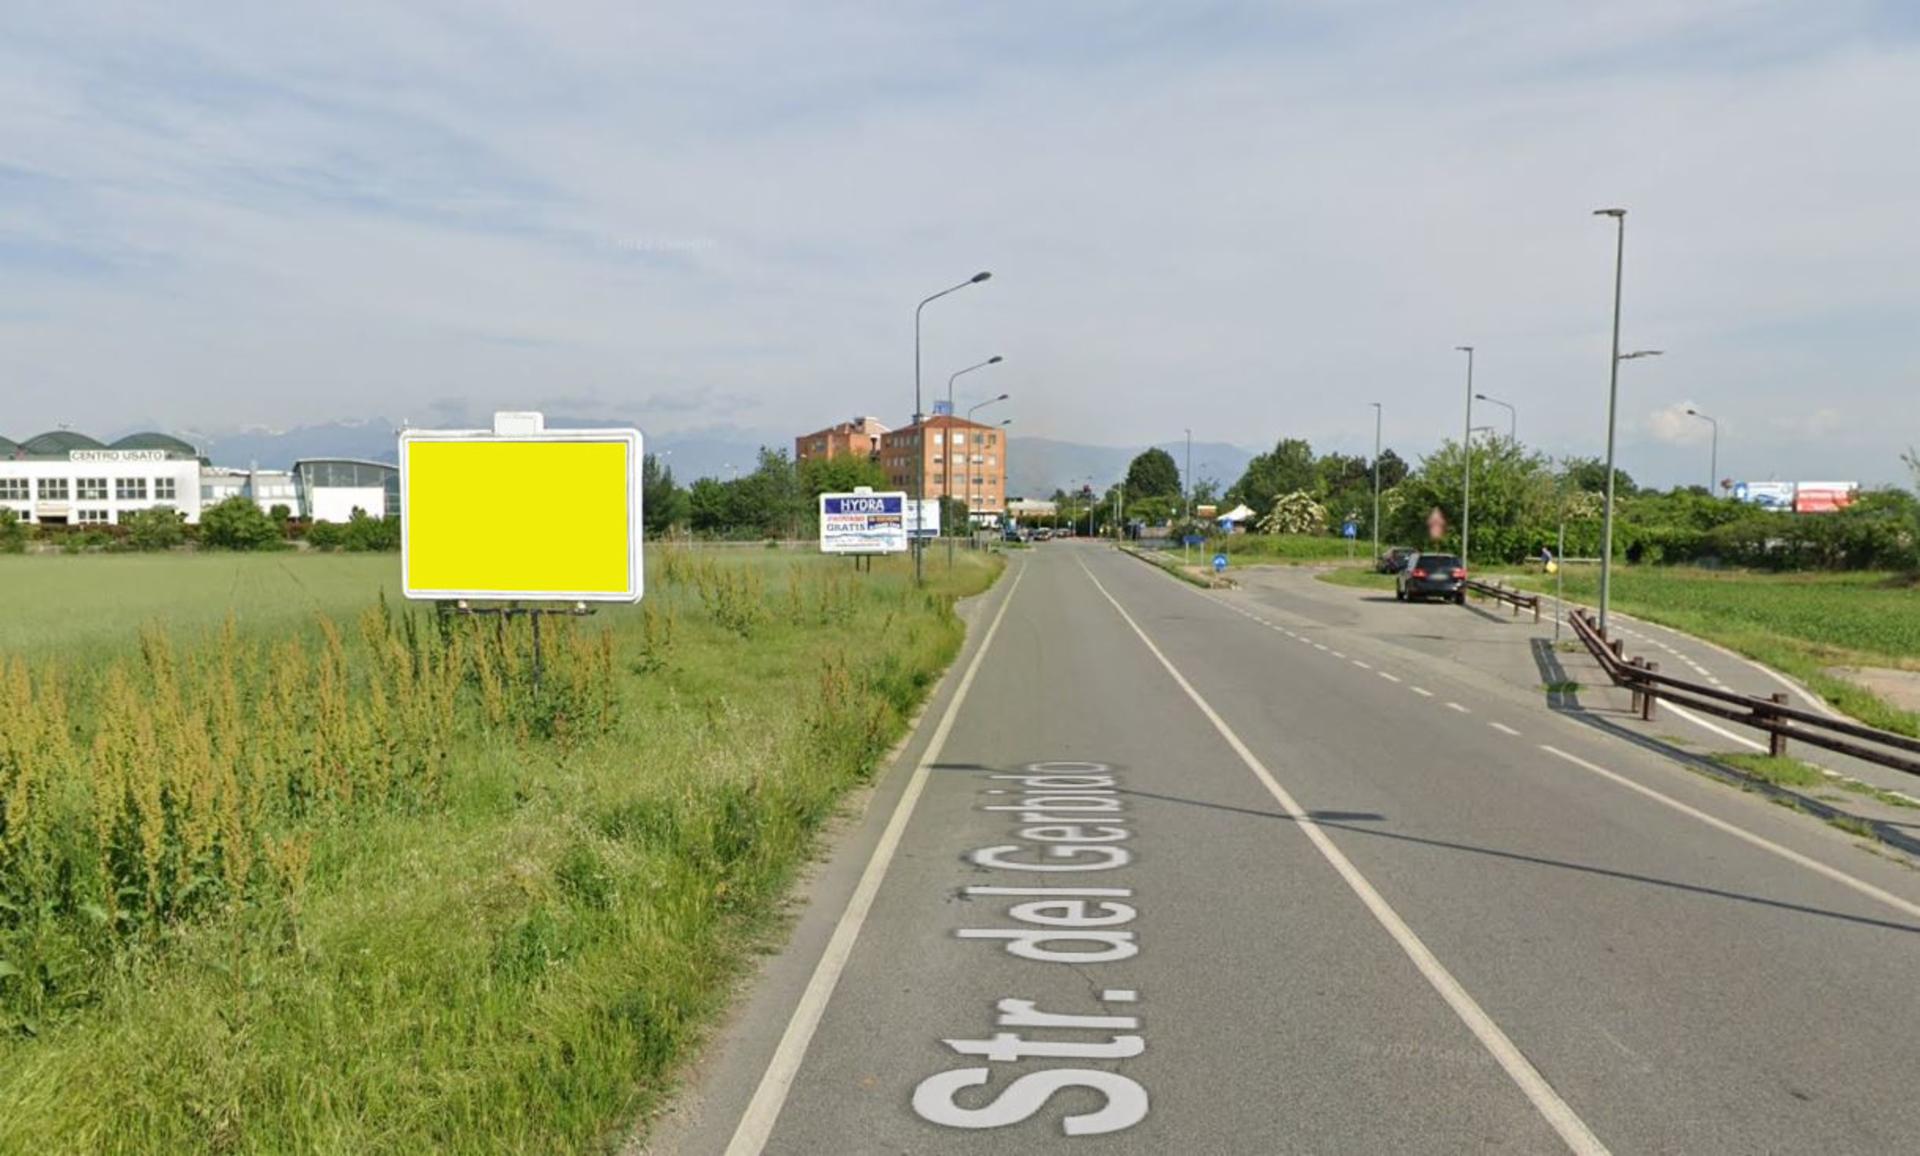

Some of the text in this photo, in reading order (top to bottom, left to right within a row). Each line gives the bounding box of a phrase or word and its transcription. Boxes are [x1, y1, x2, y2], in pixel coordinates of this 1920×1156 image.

[71, 451, 162, 461] CENTRO USATO
[840, 499, 885, 513] HYDRA
[826, 523, 866, 532] GRATIS
